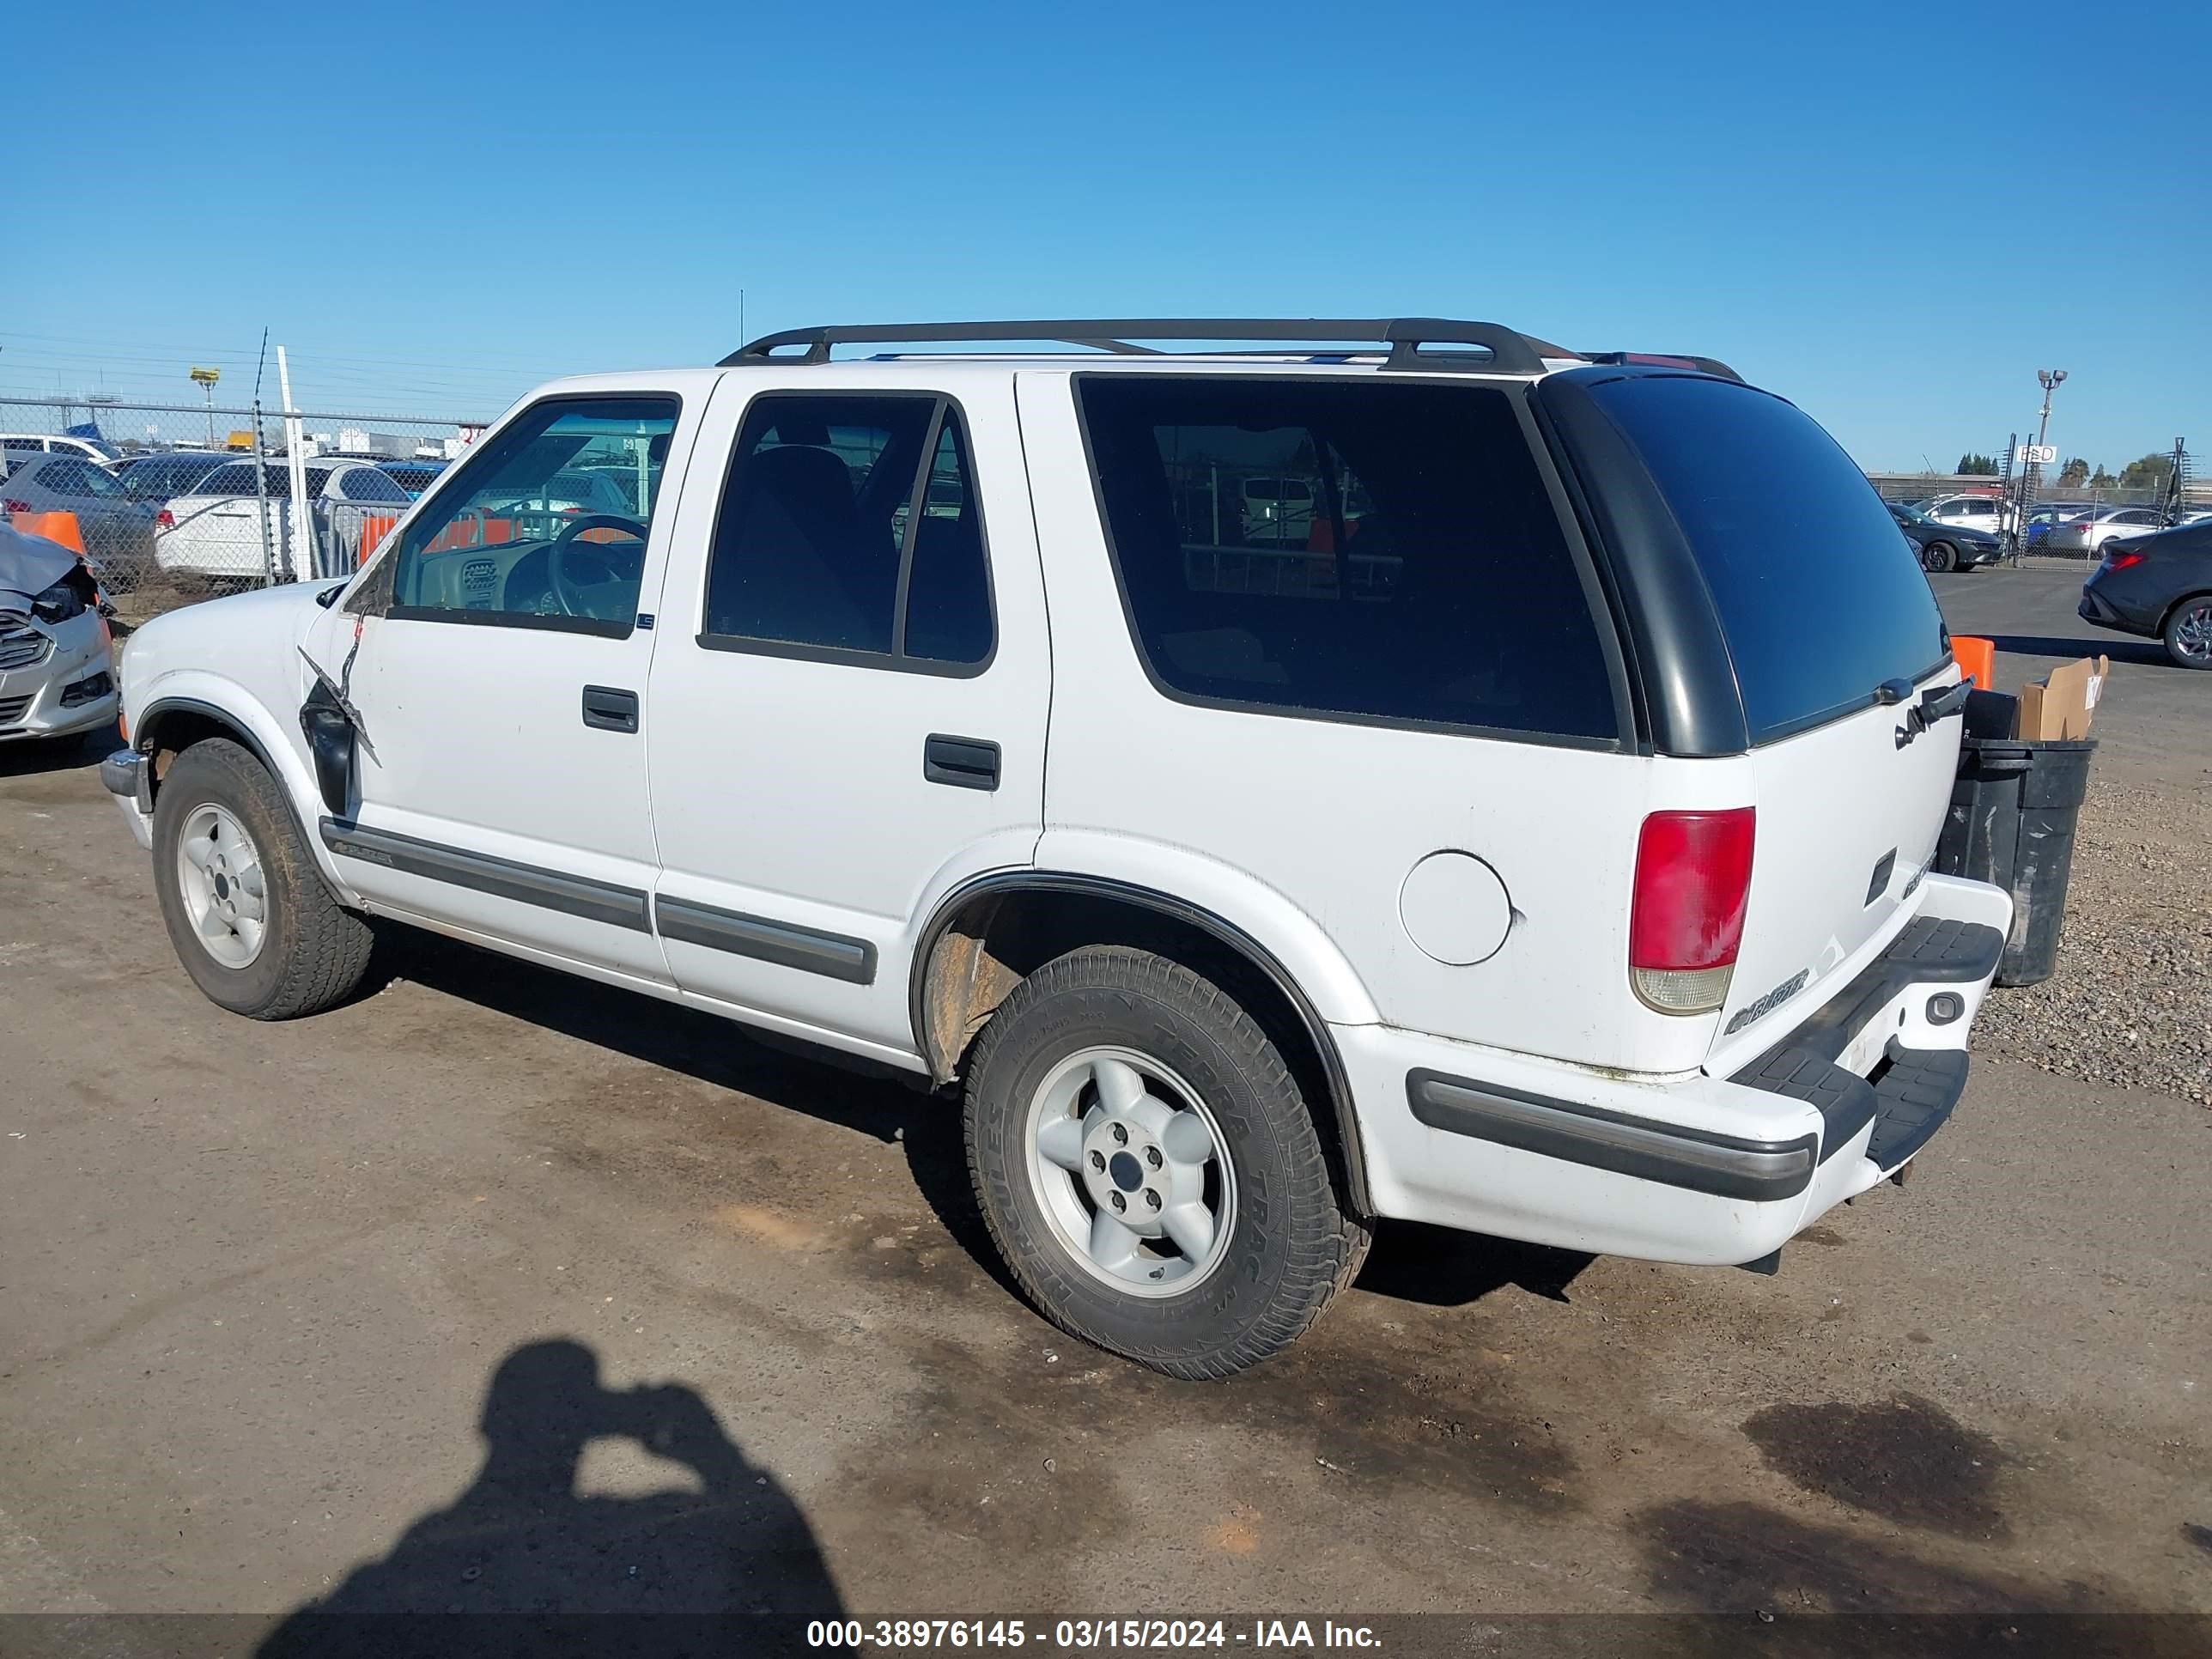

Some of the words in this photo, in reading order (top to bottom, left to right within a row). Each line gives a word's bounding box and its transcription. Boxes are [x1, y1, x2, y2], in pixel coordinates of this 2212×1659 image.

[637, 616, 654, 628] LS
[984, 1103, 1073, 1304] HERCULES
[1152, 1022, 1253, 1140] TERRA
[1243, 1169, 1270, 1285] TRAC
